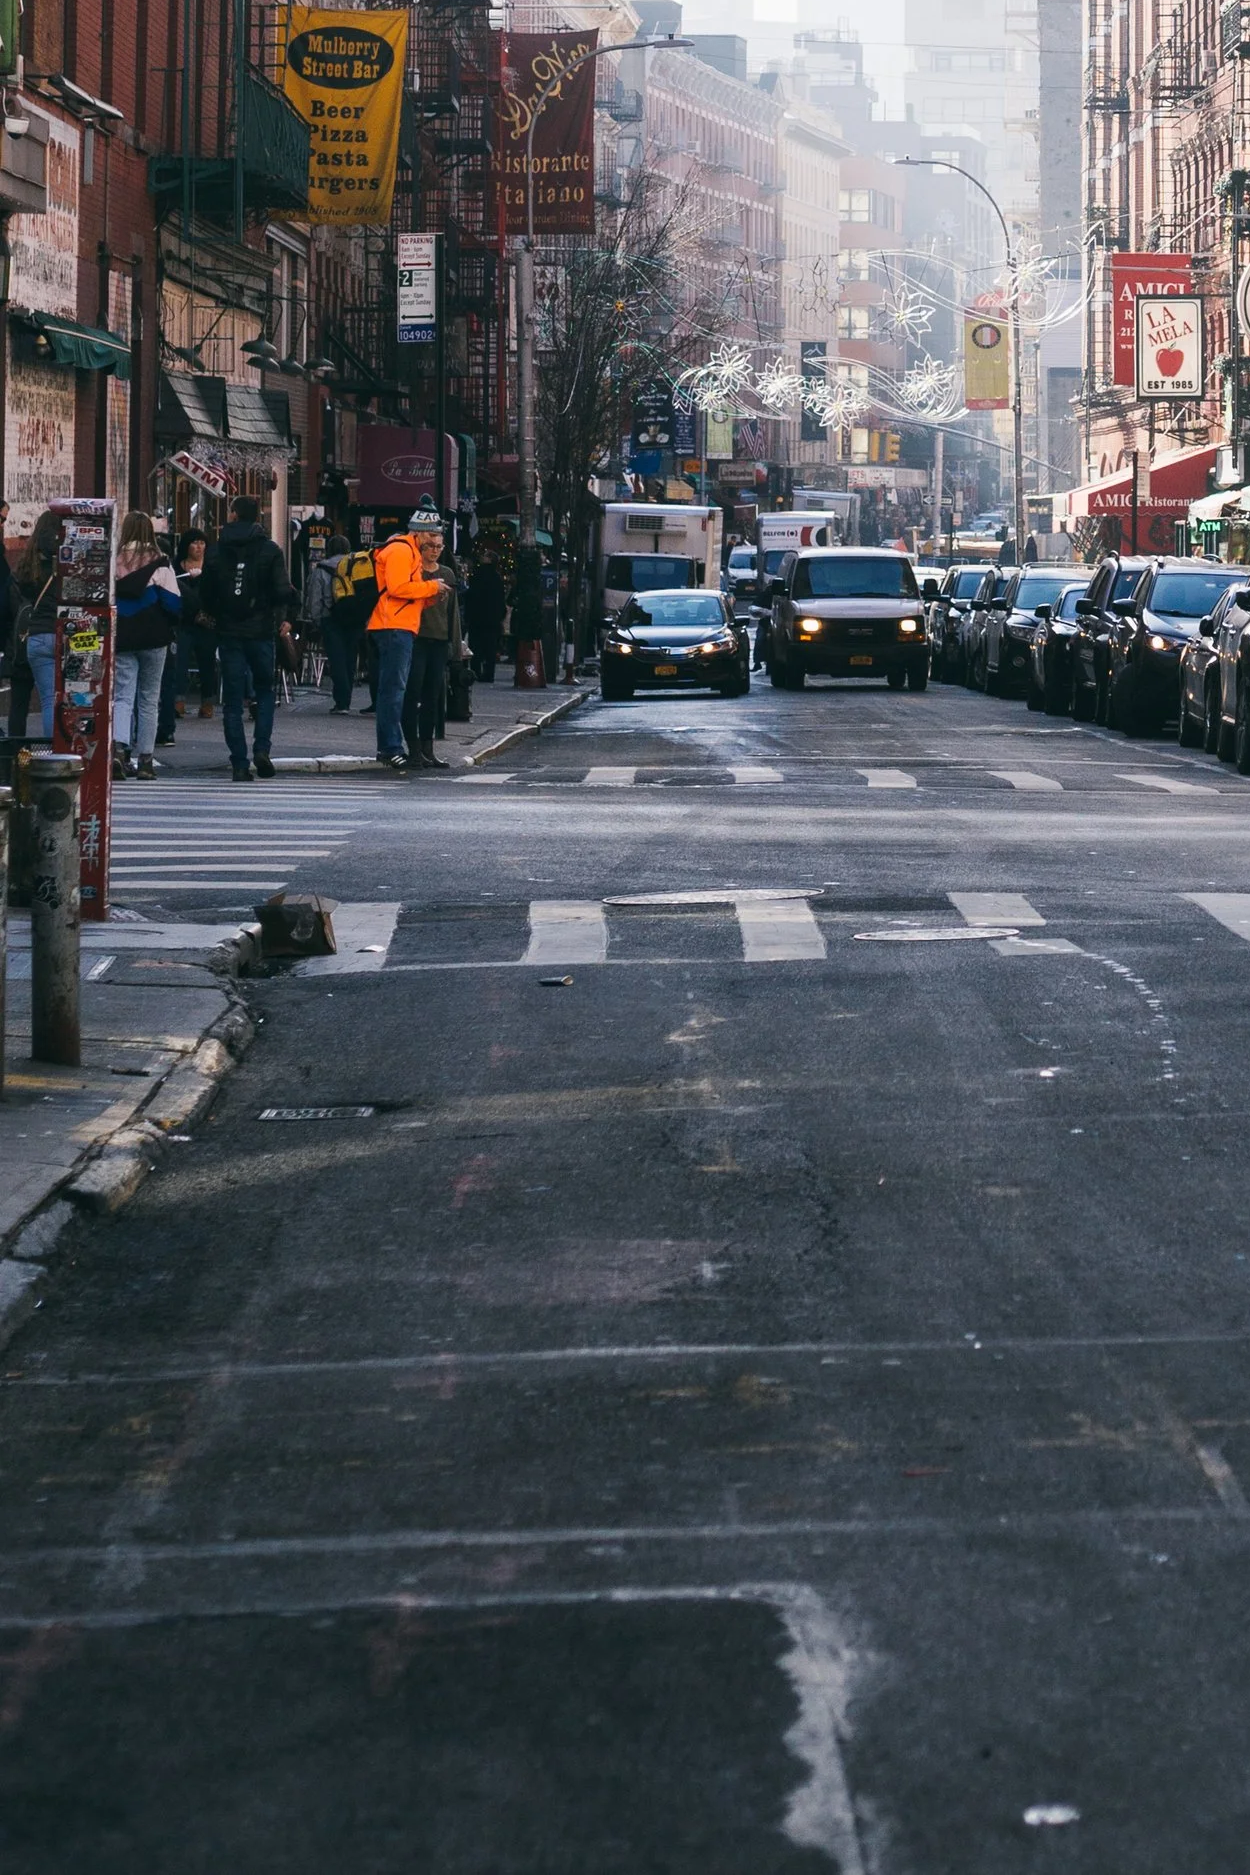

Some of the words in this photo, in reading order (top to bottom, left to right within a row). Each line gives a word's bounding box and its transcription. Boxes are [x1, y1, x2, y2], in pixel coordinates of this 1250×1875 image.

[308, 34, 380, 60] Mulberry
[302, 57, 348, 78] Street
[352, 60, 380, 79] Bar
[310, 100, 364, 119] Beer
[308, 175, 380, 195] urgers
[495, 180, 585, 204] Itaiano
[410, 237, 433, 245] PARKING
[402, 271, 410, 286] 2
[1146, 306, 1176, 328] LA
[400, 330, 433, 340] 104902
[1148, 321, 1194, 347] MELA
[1148, 381, 1166, 389] EST
[1171, 380, 1193, 389] 1985
[176, 455, 220, 488] ATM
[1199, 522, 1221, 531] ATM
[360, 534, 374, 543] CITY
